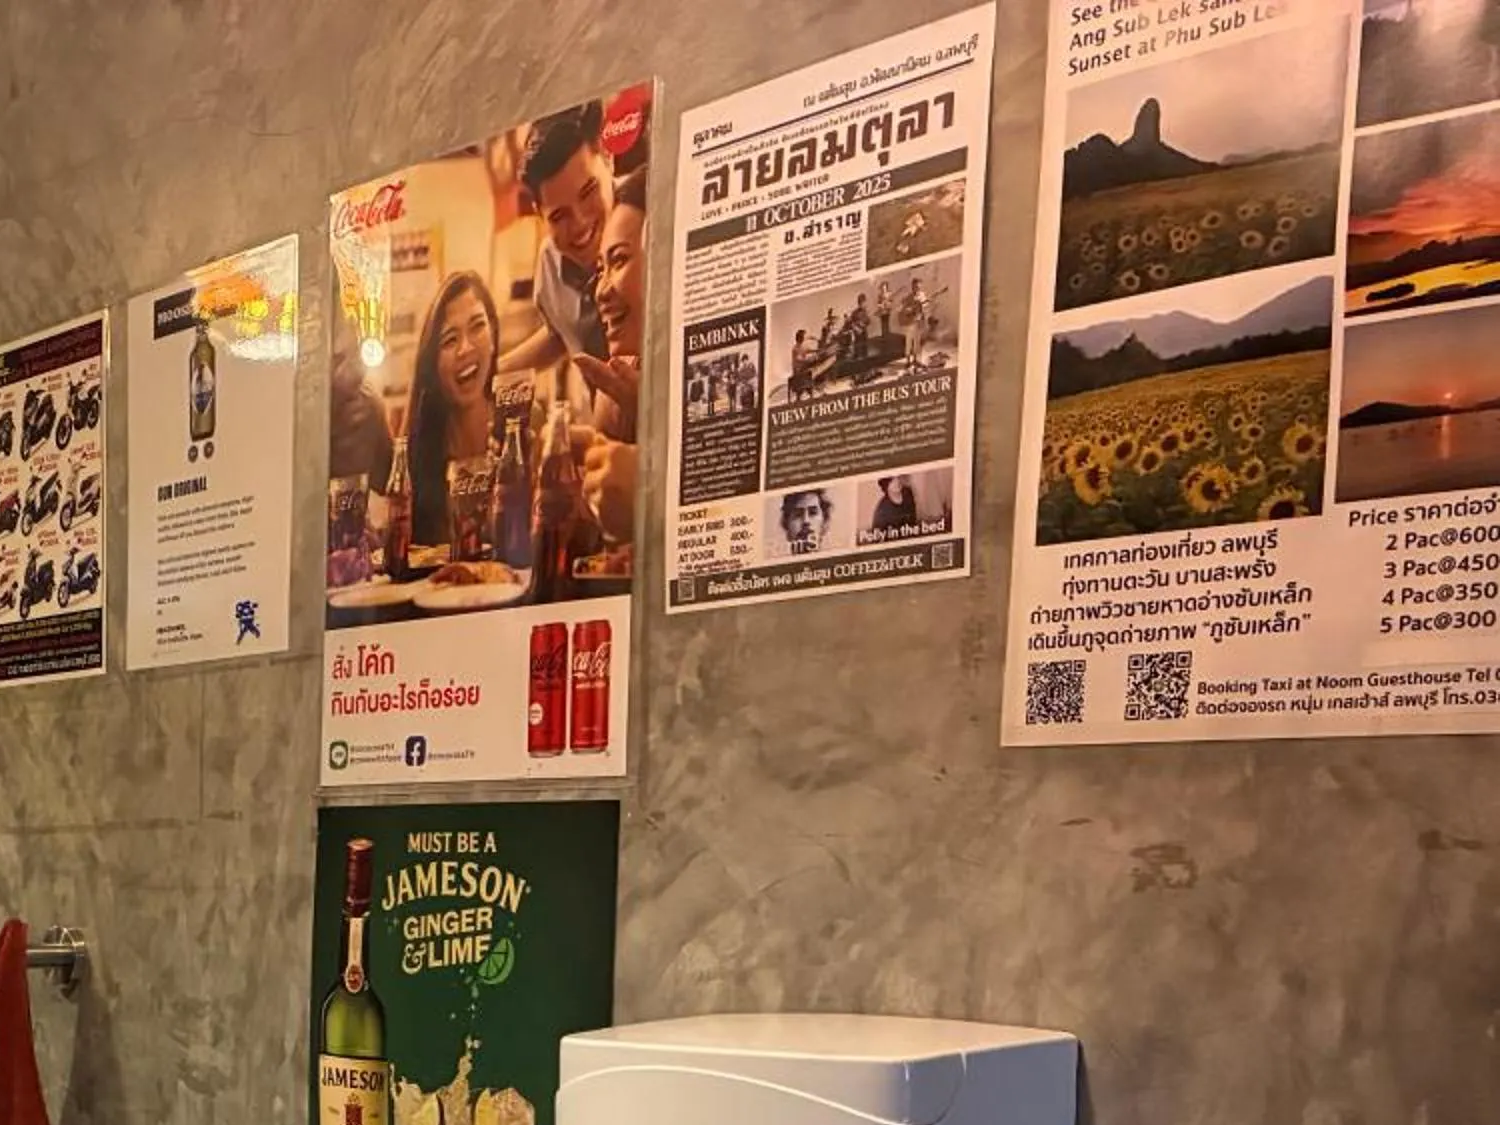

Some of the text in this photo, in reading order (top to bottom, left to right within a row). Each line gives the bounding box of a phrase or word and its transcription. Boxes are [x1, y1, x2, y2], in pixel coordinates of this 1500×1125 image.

[1069, 28, 1106, 52] Ang
[1113, 14, 1150, 38] Sub
[1157, 2, 1192, 25] Lek
[1071, 4, 1102, 27] See
[1067, 44, 1132, 77] Sunset
[1137, 37, 1157, 57] at
[1164, 26, 1201, 48] Phu
[1208, 11, 1247, 36] Sub
[702, 91, 955, 205] สายลมตุลา
[763, 187, 845, 226] OCTOBER
[852, 173, 891, 200] 2025
[771, 375, 951, 426] VIEW FROM THE BUS TOUR
[1349, 492, 1500, 528] Price ราคาต่อจ
[900, 523, 920, 537] the
[921, 517, 945, 534] bed
[1385, 525, 1500, 551] 2 Pac@600
[1064, 528, 1278, 569] เทศกาลท่องเที่ยว ลพบุรี
[1062, 558, 1277, 600] ทุ่งทานตะวัน บานสะพรั่ง
[1383, 553, 1500, 579] 3 Pac@450
[1381, 581, 1498, 605] 4 Pac@350
[1380, 609, 1497, 633] 5 Pac@300
[357, 644, 395, 676] โค้ก
[332, 678, 480, 716] กินกับอะไรก็อร่อย
[1197, 680, 1257, 696] Booking
[1262, 677, 1292, 692] Taxi
[1296, 678, 1311, 690] at
[1316, 675, 1363, 690] Noom
[1367, 670, 1461, 688] Guesthouse
[1466, 667, 1491, 683] Tel
[1393, 689, 1438, 710] ลพบุรี
[1442, 686, 1500, 706] โทร.03
[408, 831, 497, 853] MUST BE A
[381, 861, 526, 913] JAMESON
[403, 907, 493, 940] GINGER
